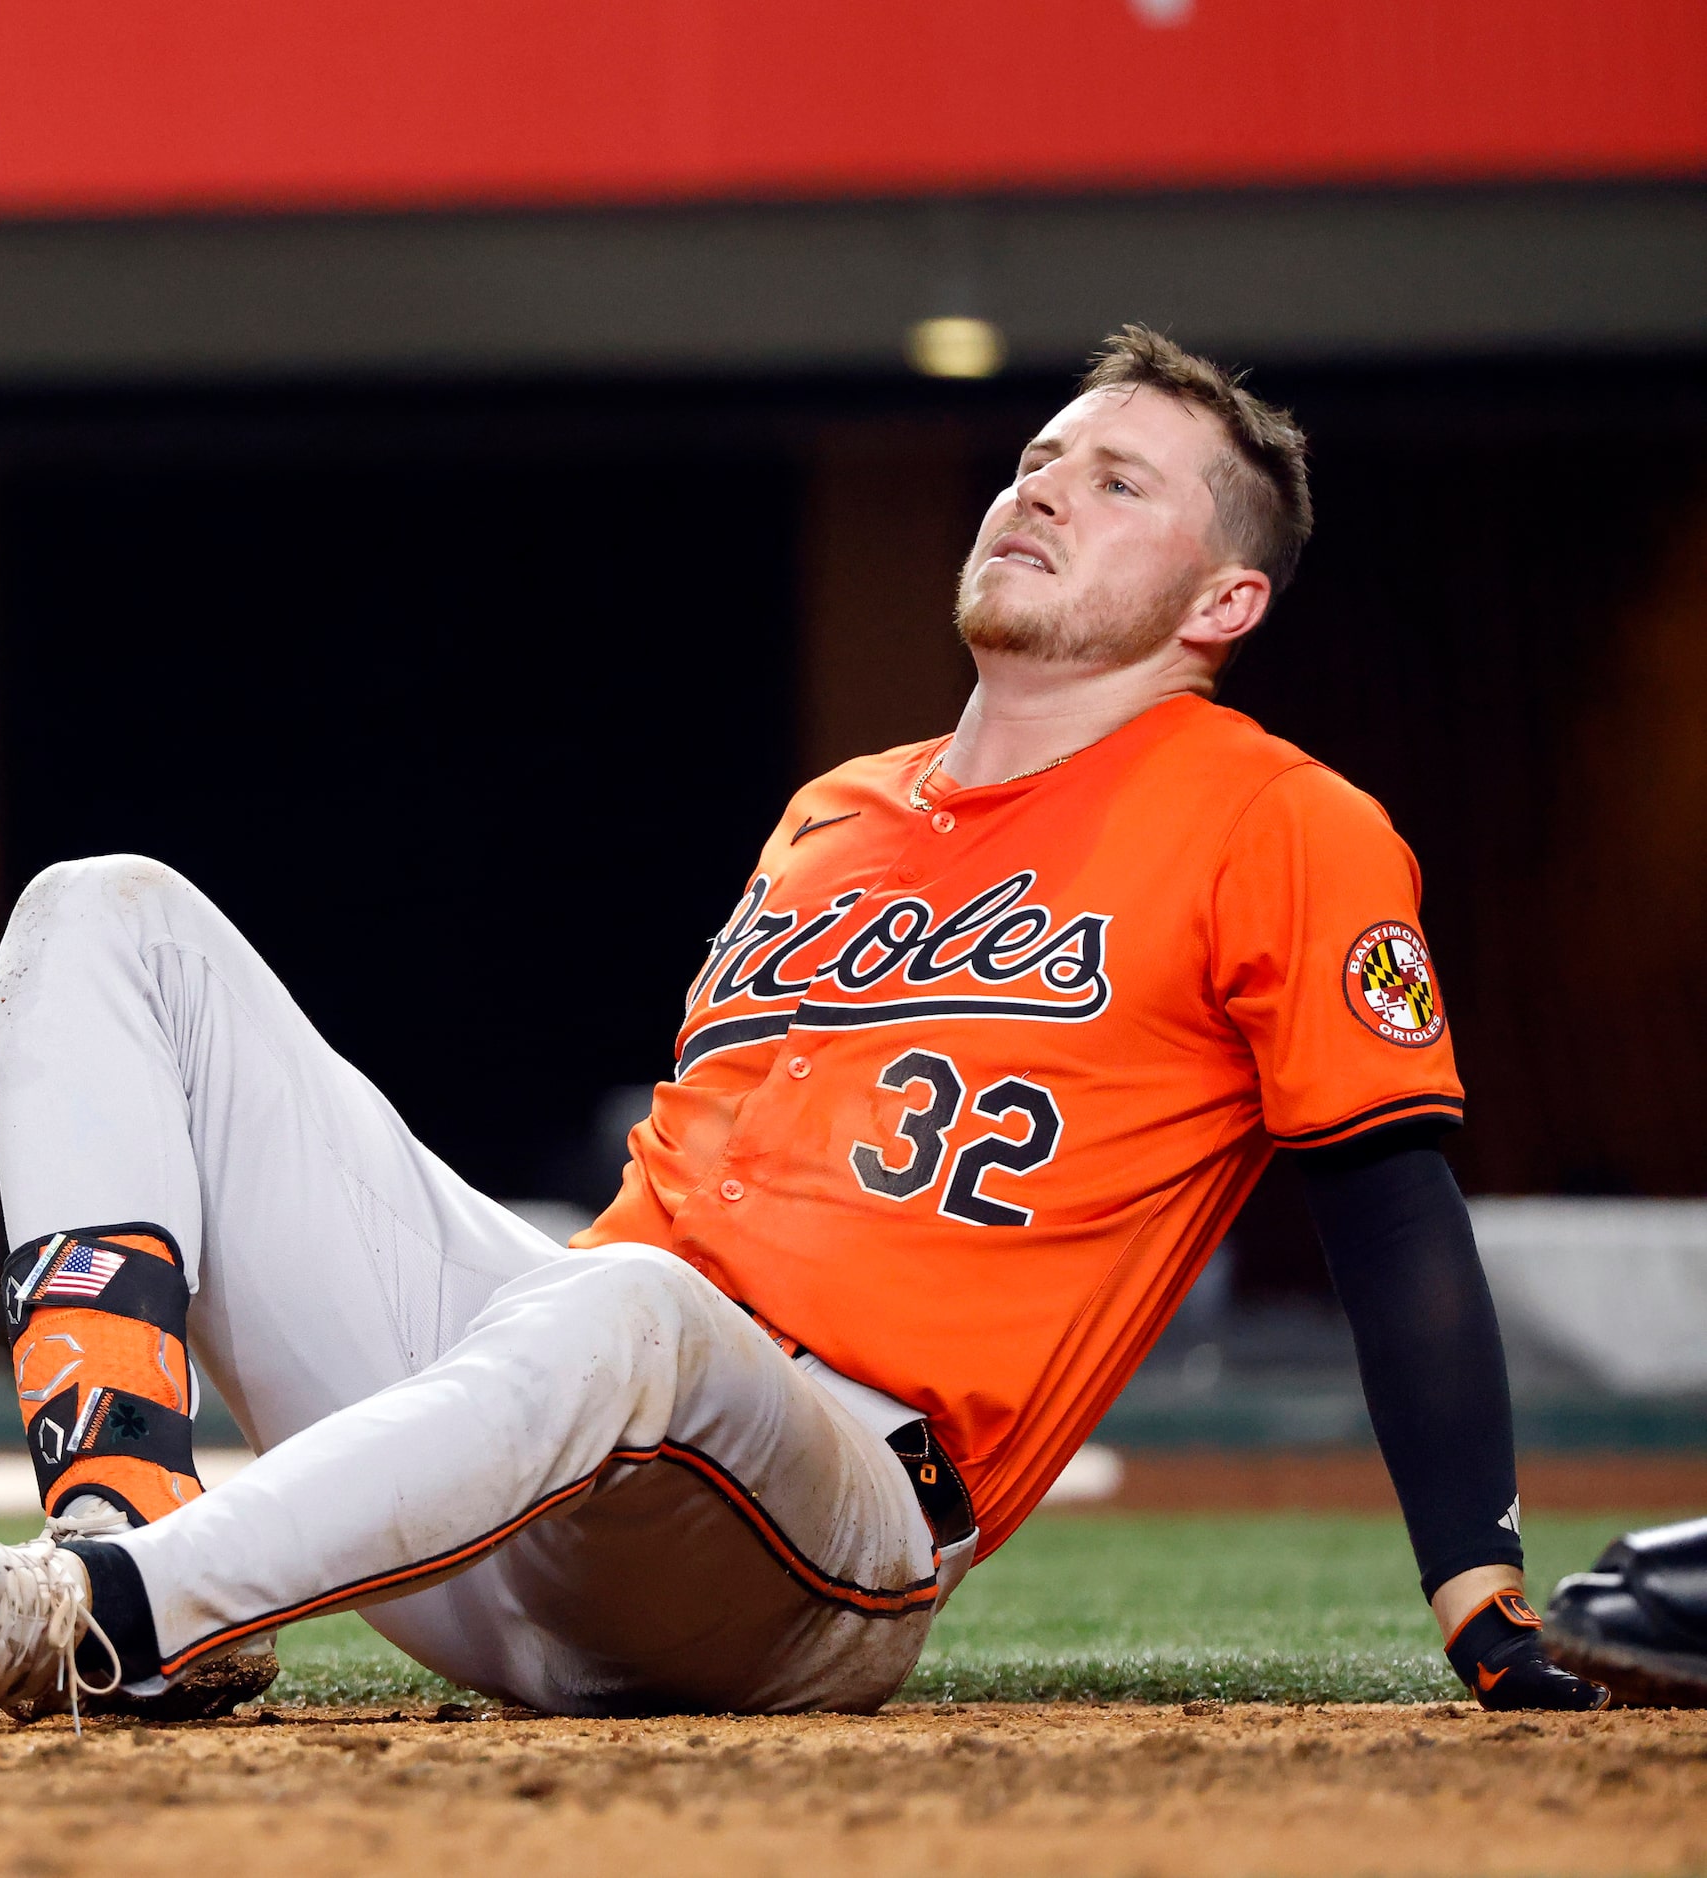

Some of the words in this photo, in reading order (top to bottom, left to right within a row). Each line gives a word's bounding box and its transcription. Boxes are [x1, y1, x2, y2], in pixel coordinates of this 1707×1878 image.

[1349, 926, 1428, 974] BALTIMORE
[1379, 1014, 1441, 1042] ORIOLES
[848, 1047, 1064, 1227] 32
